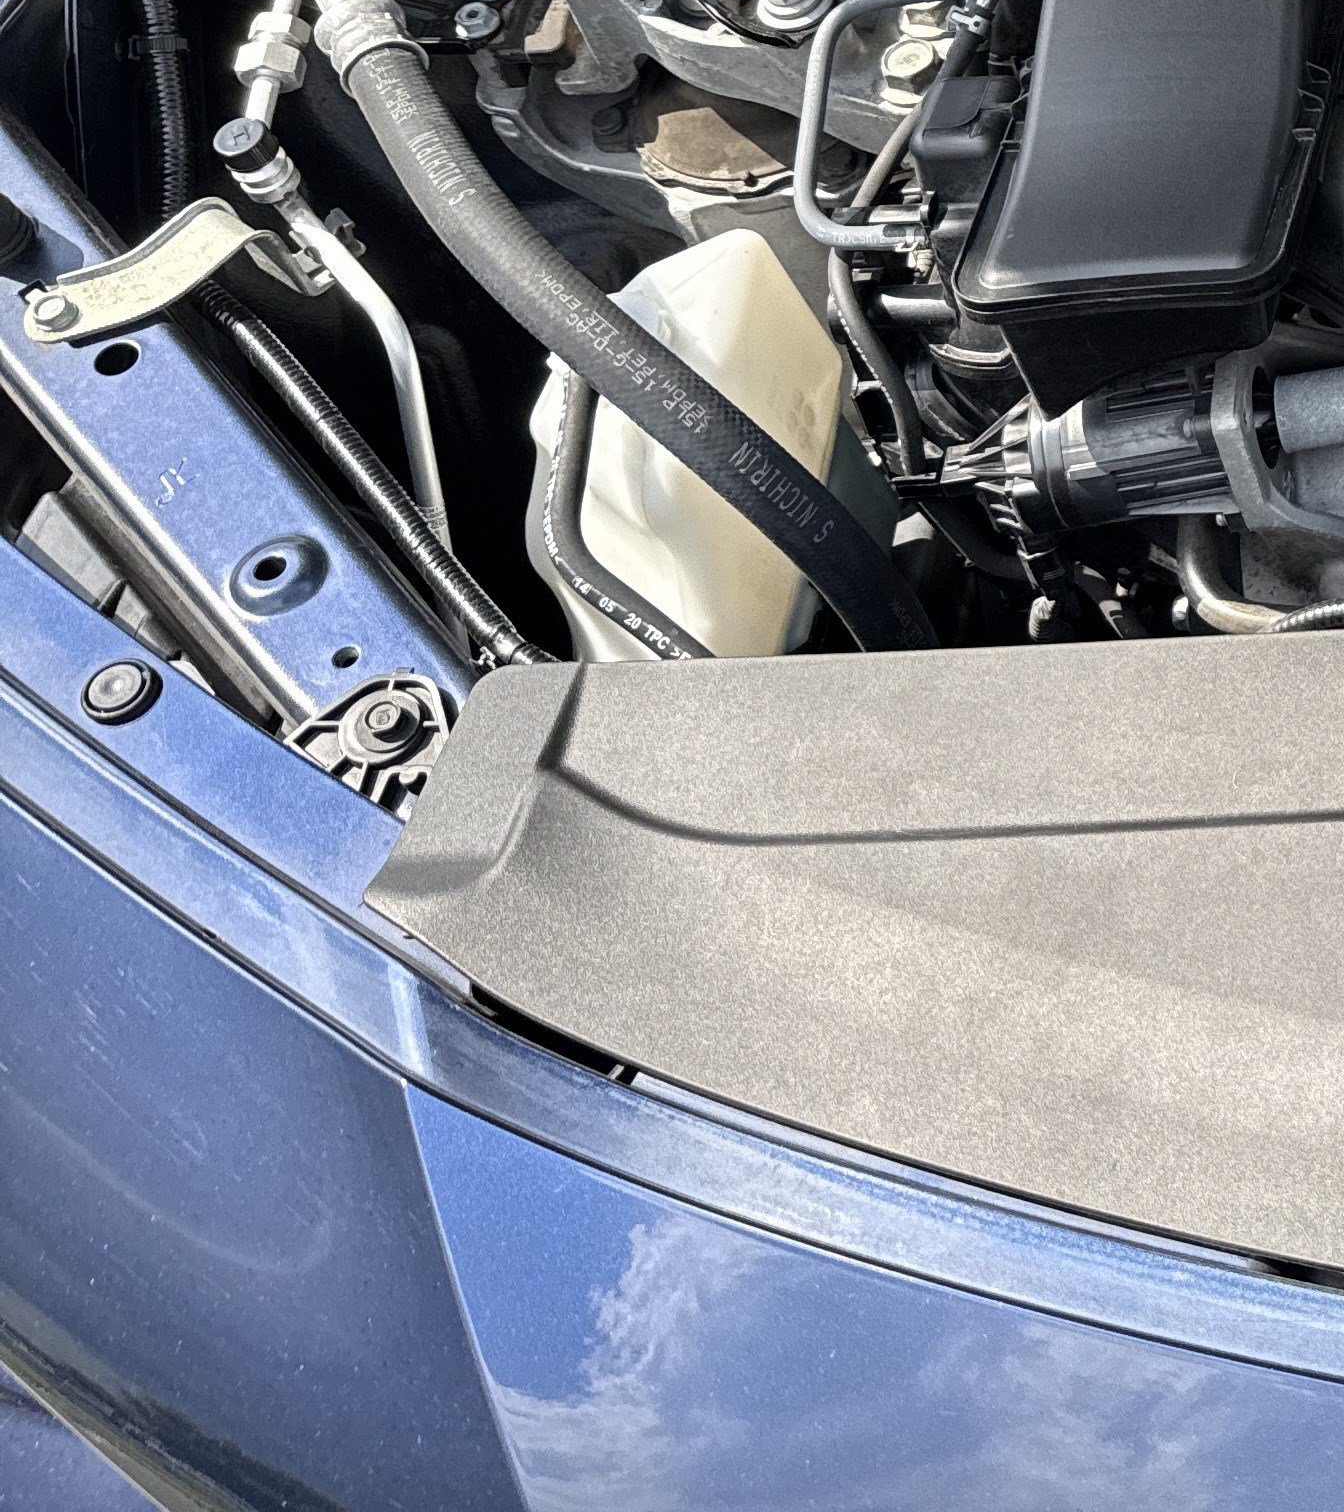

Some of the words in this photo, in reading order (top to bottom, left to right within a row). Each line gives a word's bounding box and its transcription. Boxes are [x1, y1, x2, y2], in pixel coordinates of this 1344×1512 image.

[660, 392, 706, 435] 15LP
[596, 594, 617, 614] 05
[622, 610, 644, 631] 20
[641, 623, 671, 652] TPC
